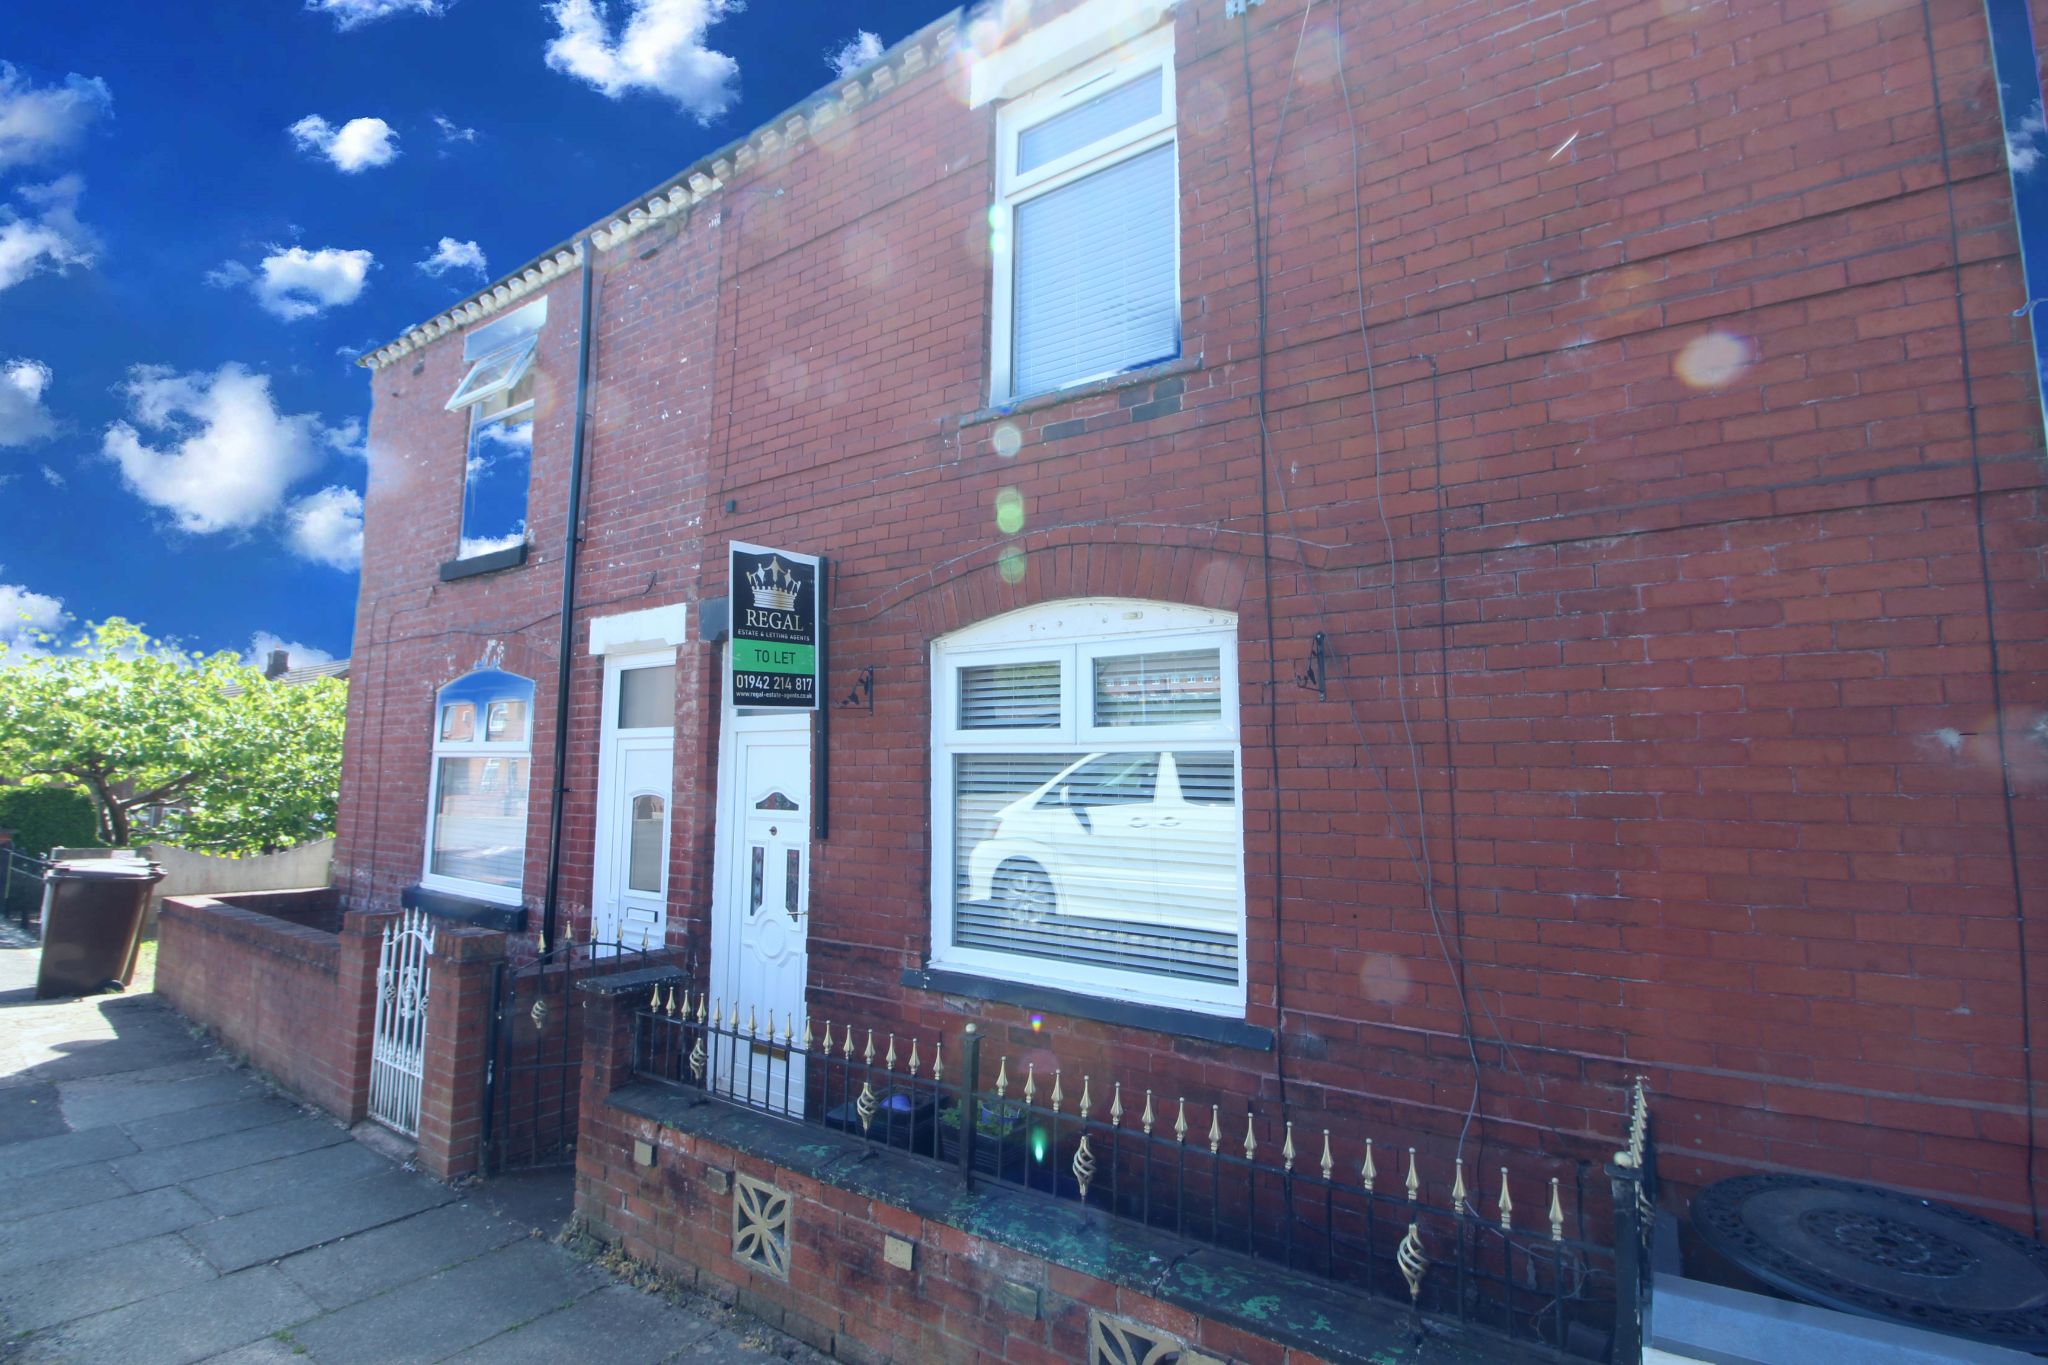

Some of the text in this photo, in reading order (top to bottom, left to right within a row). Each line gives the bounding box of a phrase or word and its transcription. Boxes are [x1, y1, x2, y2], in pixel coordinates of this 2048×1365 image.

[746, 609, 804, 631] REGAL
[738, 628, 759, 637] ESTATE
[766, 632, 788, 640] LETTING
[790, 634, 810, 642] AGENTS
[754, 649, 796, 665] TO LET
[736, 674, 812, 691] 01942 214 817
